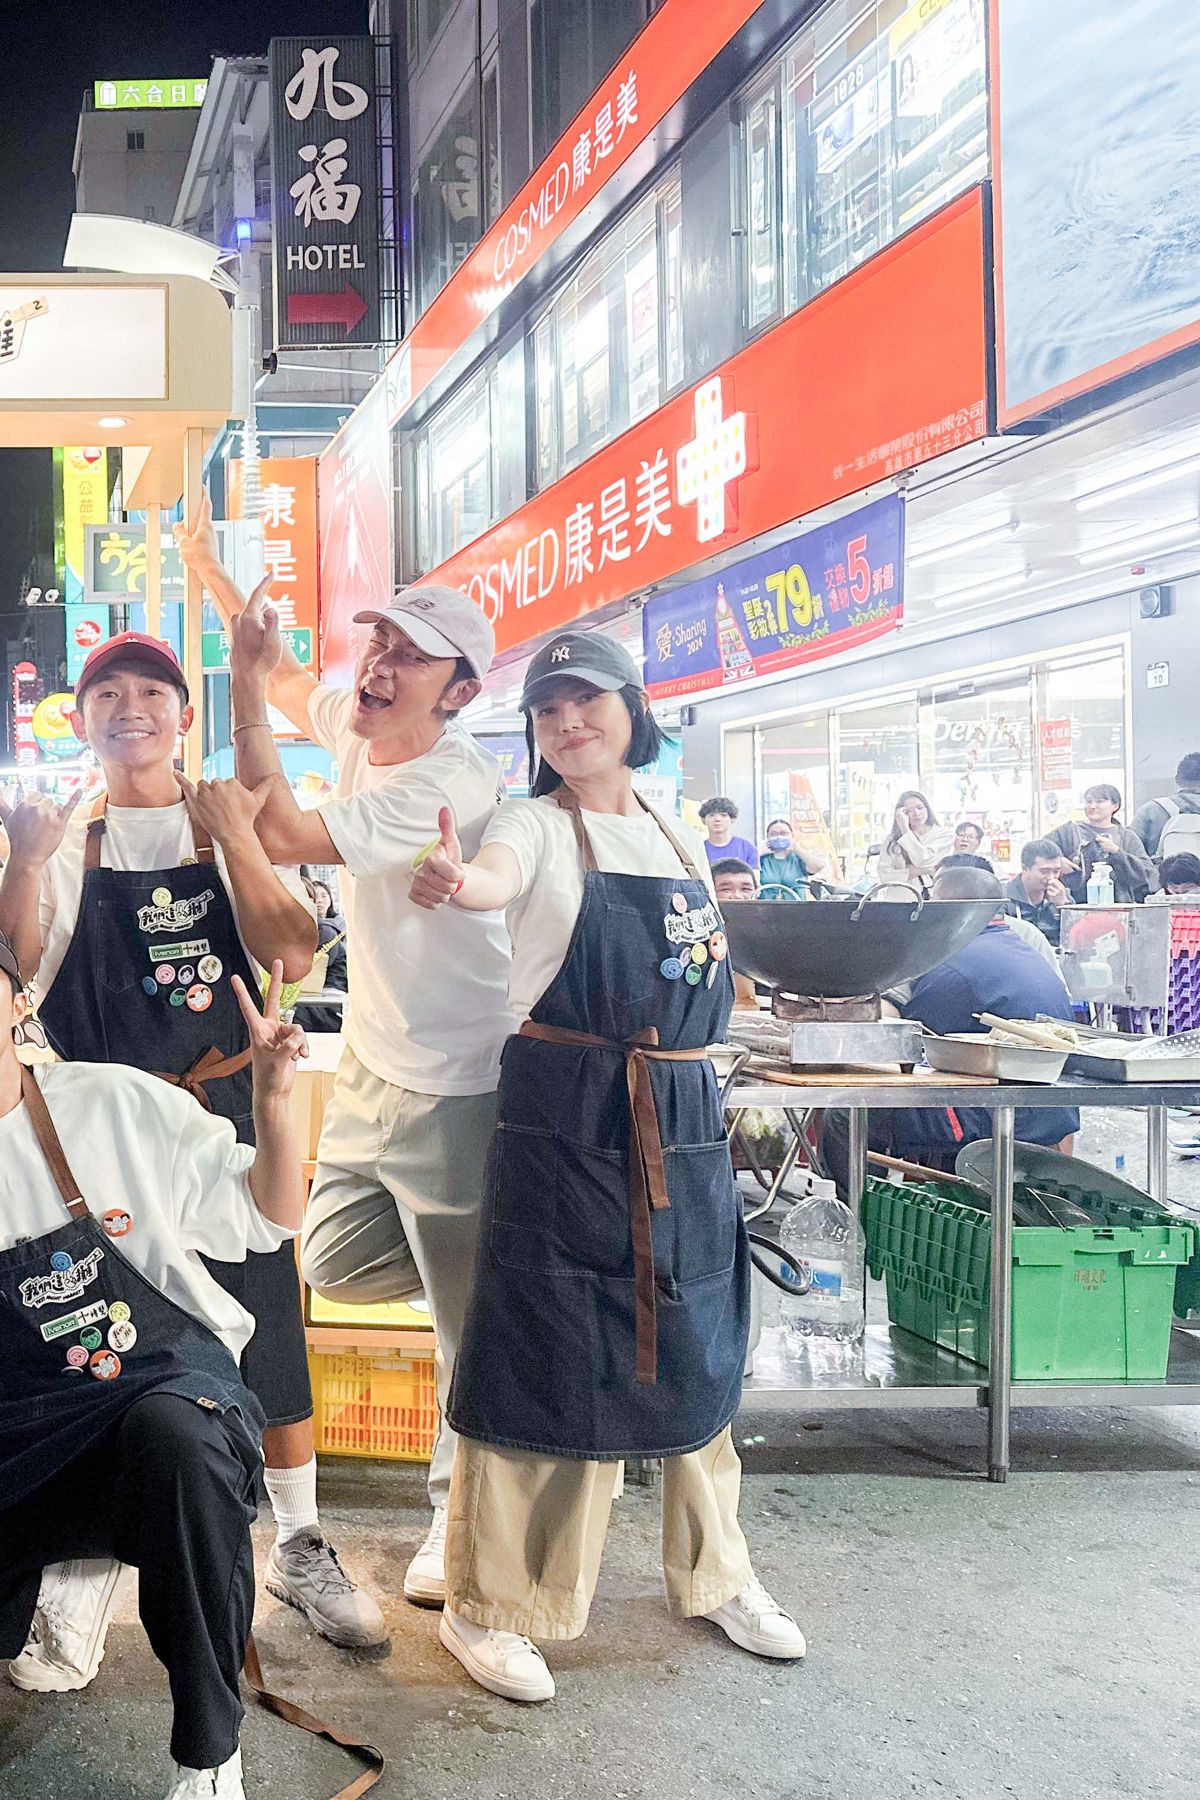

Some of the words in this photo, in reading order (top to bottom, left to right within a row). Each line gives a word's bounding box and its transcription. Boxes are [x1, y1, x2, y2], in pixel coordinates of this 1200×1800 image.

[284, 47, 369, 228] 九福
[494, 162, 569, 281] COSMED
[572, 69, 638, 197] 康是美
[287, 244, 365, 271] HOTEL
[457, 528, 559, 625] OSMED
[564, 448, 672, 590] 康是美
[765, 563, 813, 633] 79
[847, 534, 871, 604] 5
